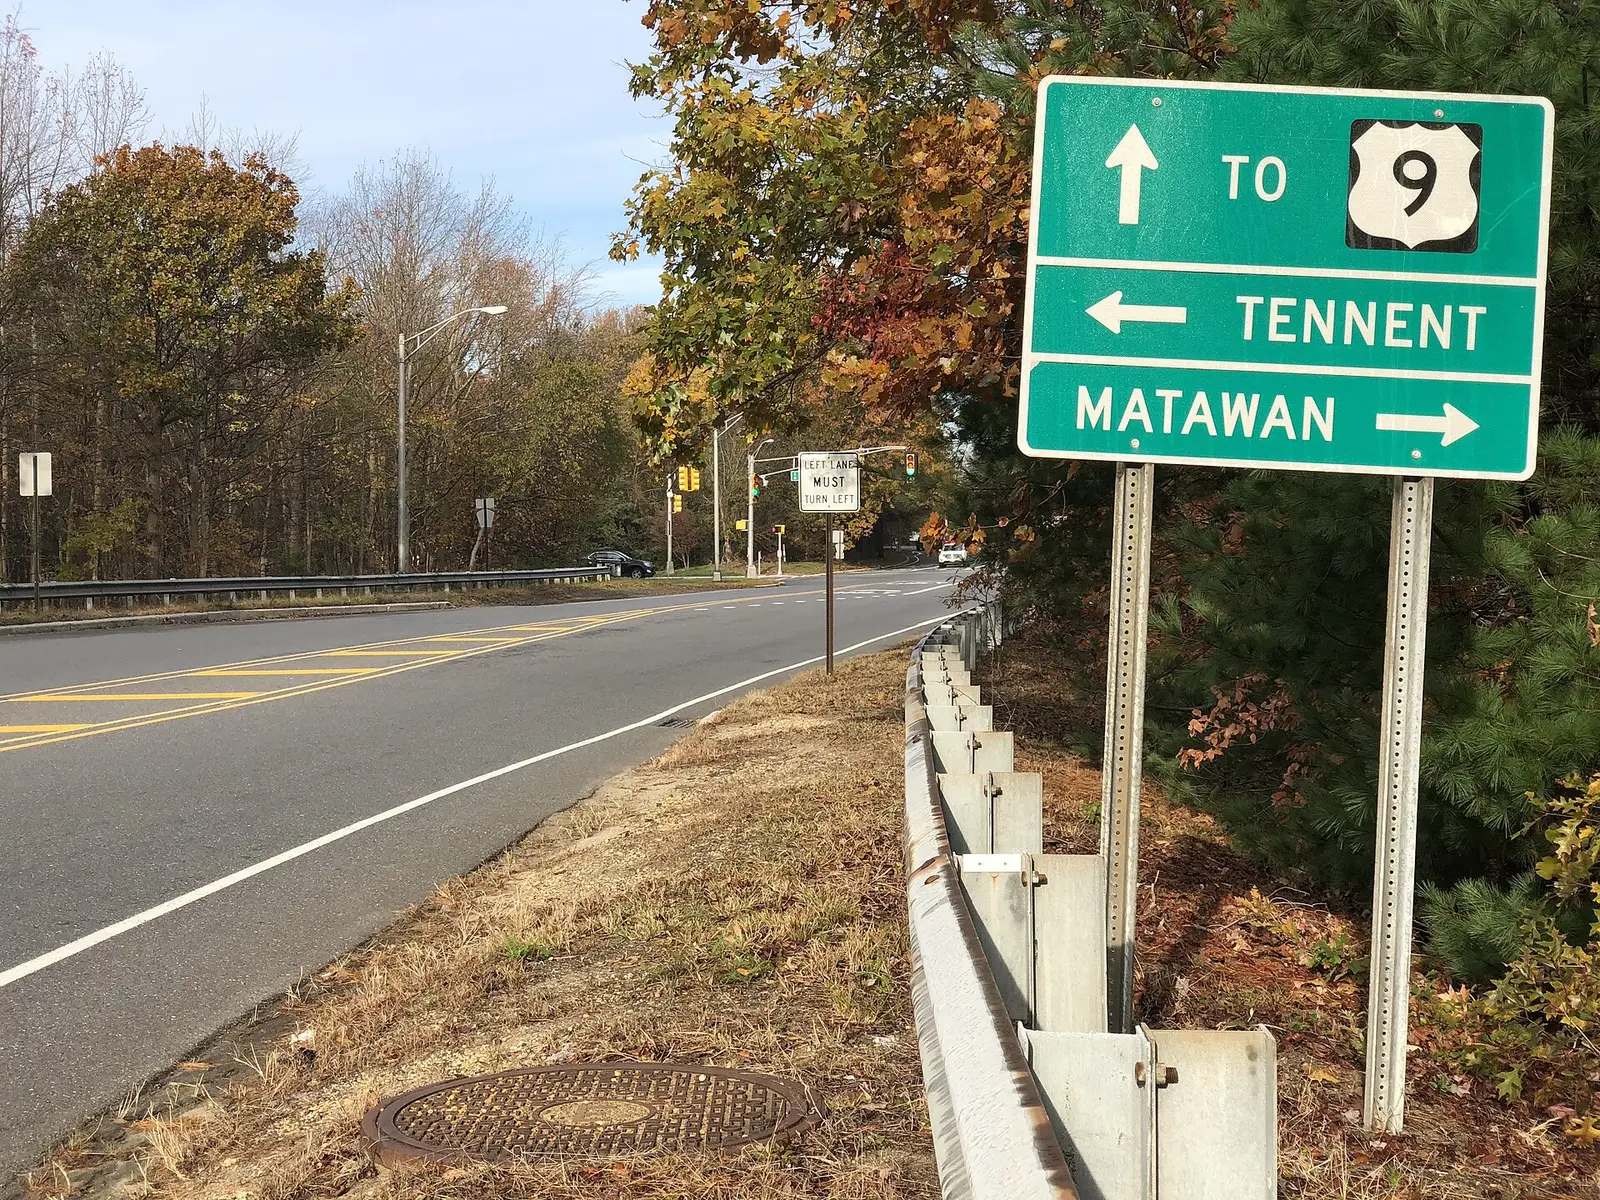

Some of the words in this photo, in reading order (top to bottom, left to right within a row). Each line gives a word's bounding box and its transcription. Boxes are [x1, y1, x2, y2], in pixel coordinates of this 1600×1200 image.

[1221, 155, 1287, 202] TO
[1392, 150, 1438, 218] 9
[1236, 295, 1487, 351] TENNENT
[1076, 385, 1335, 442] MATAWAN
[804, 460, 826, 470] LEFT
[830, 460, 854, 470] LANE
[813, 476, 845, 488] MUST
[804, 494, 828, 504] TURN
[832, 494, 855, 504] LEFT
